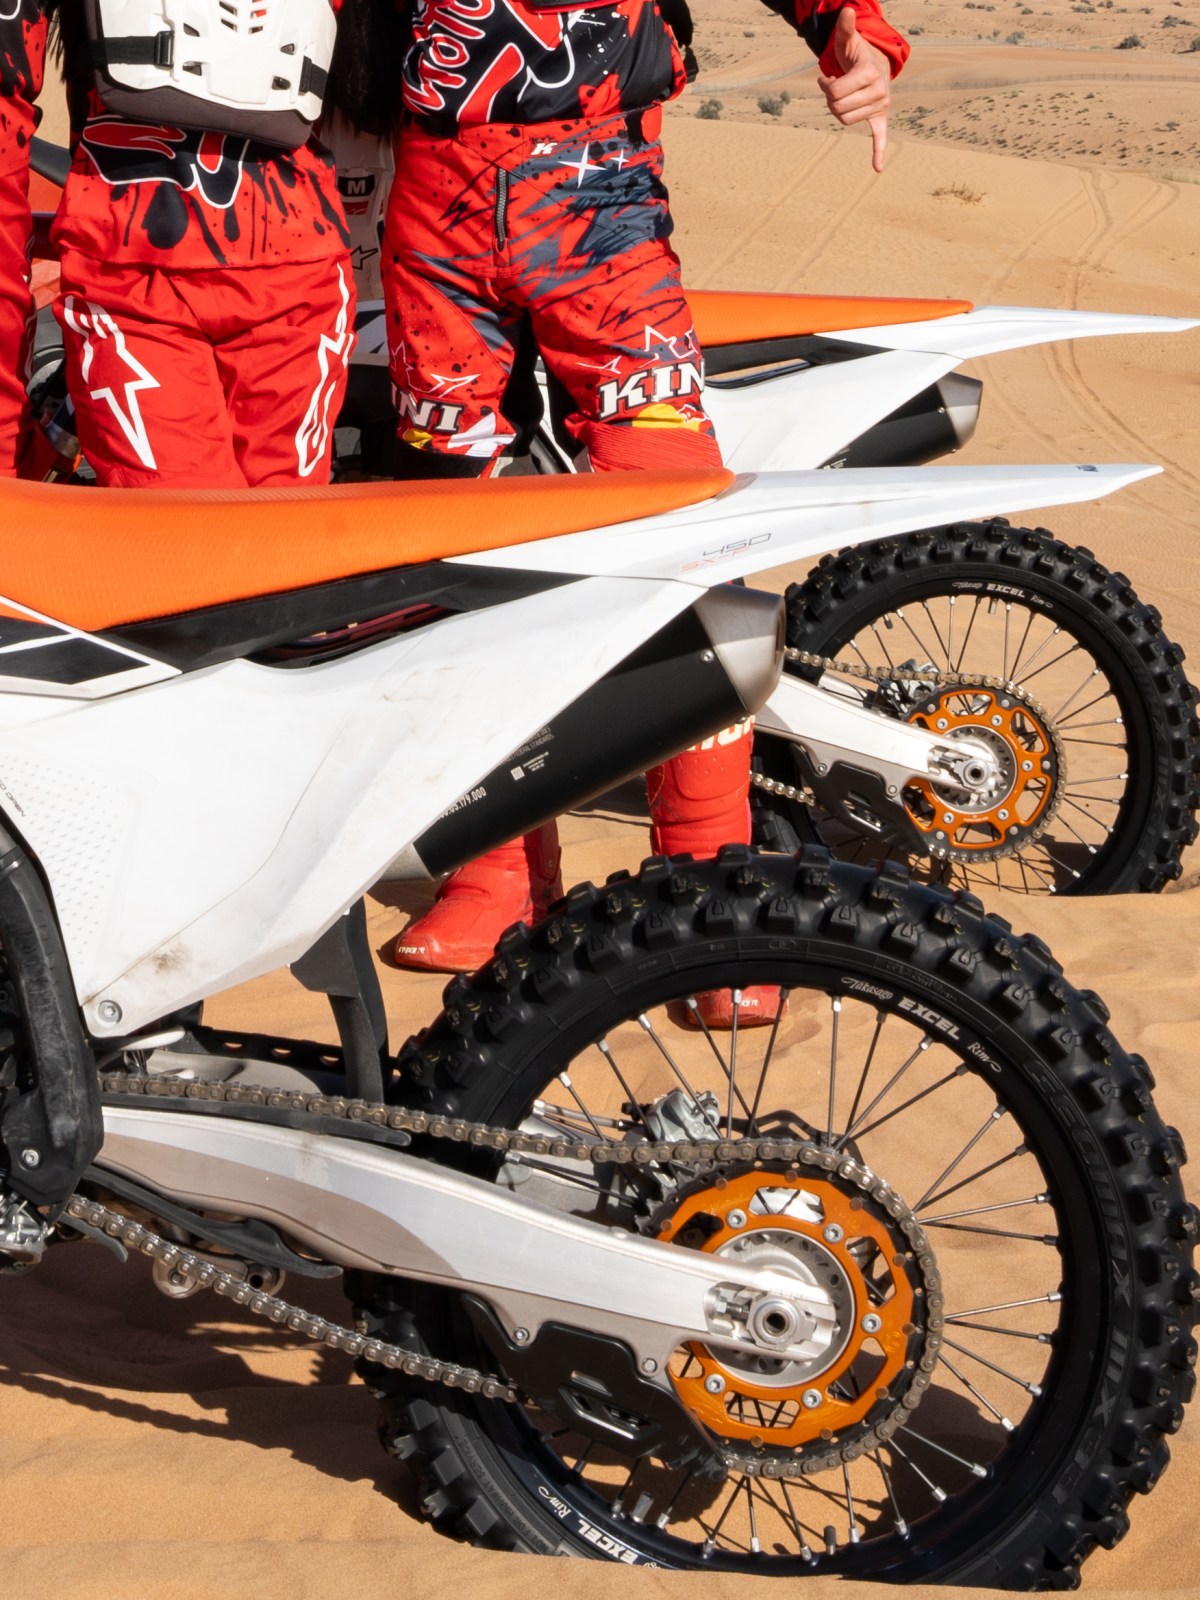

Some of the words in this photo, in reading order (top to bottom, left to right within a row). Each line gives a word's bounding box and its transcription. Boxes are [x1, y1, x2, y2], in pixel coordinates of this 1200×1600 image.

[986, 583, 1026, 599] EXCEL
[840, 976, 894, 1000] Takasago
[897, 996, 960, 1040] EXCEL
[967, 1041, 1002, 1073] Rim
[538, 1485, 572, 1519] Rim
[577, 1518, 639, 1566] EXCEL
